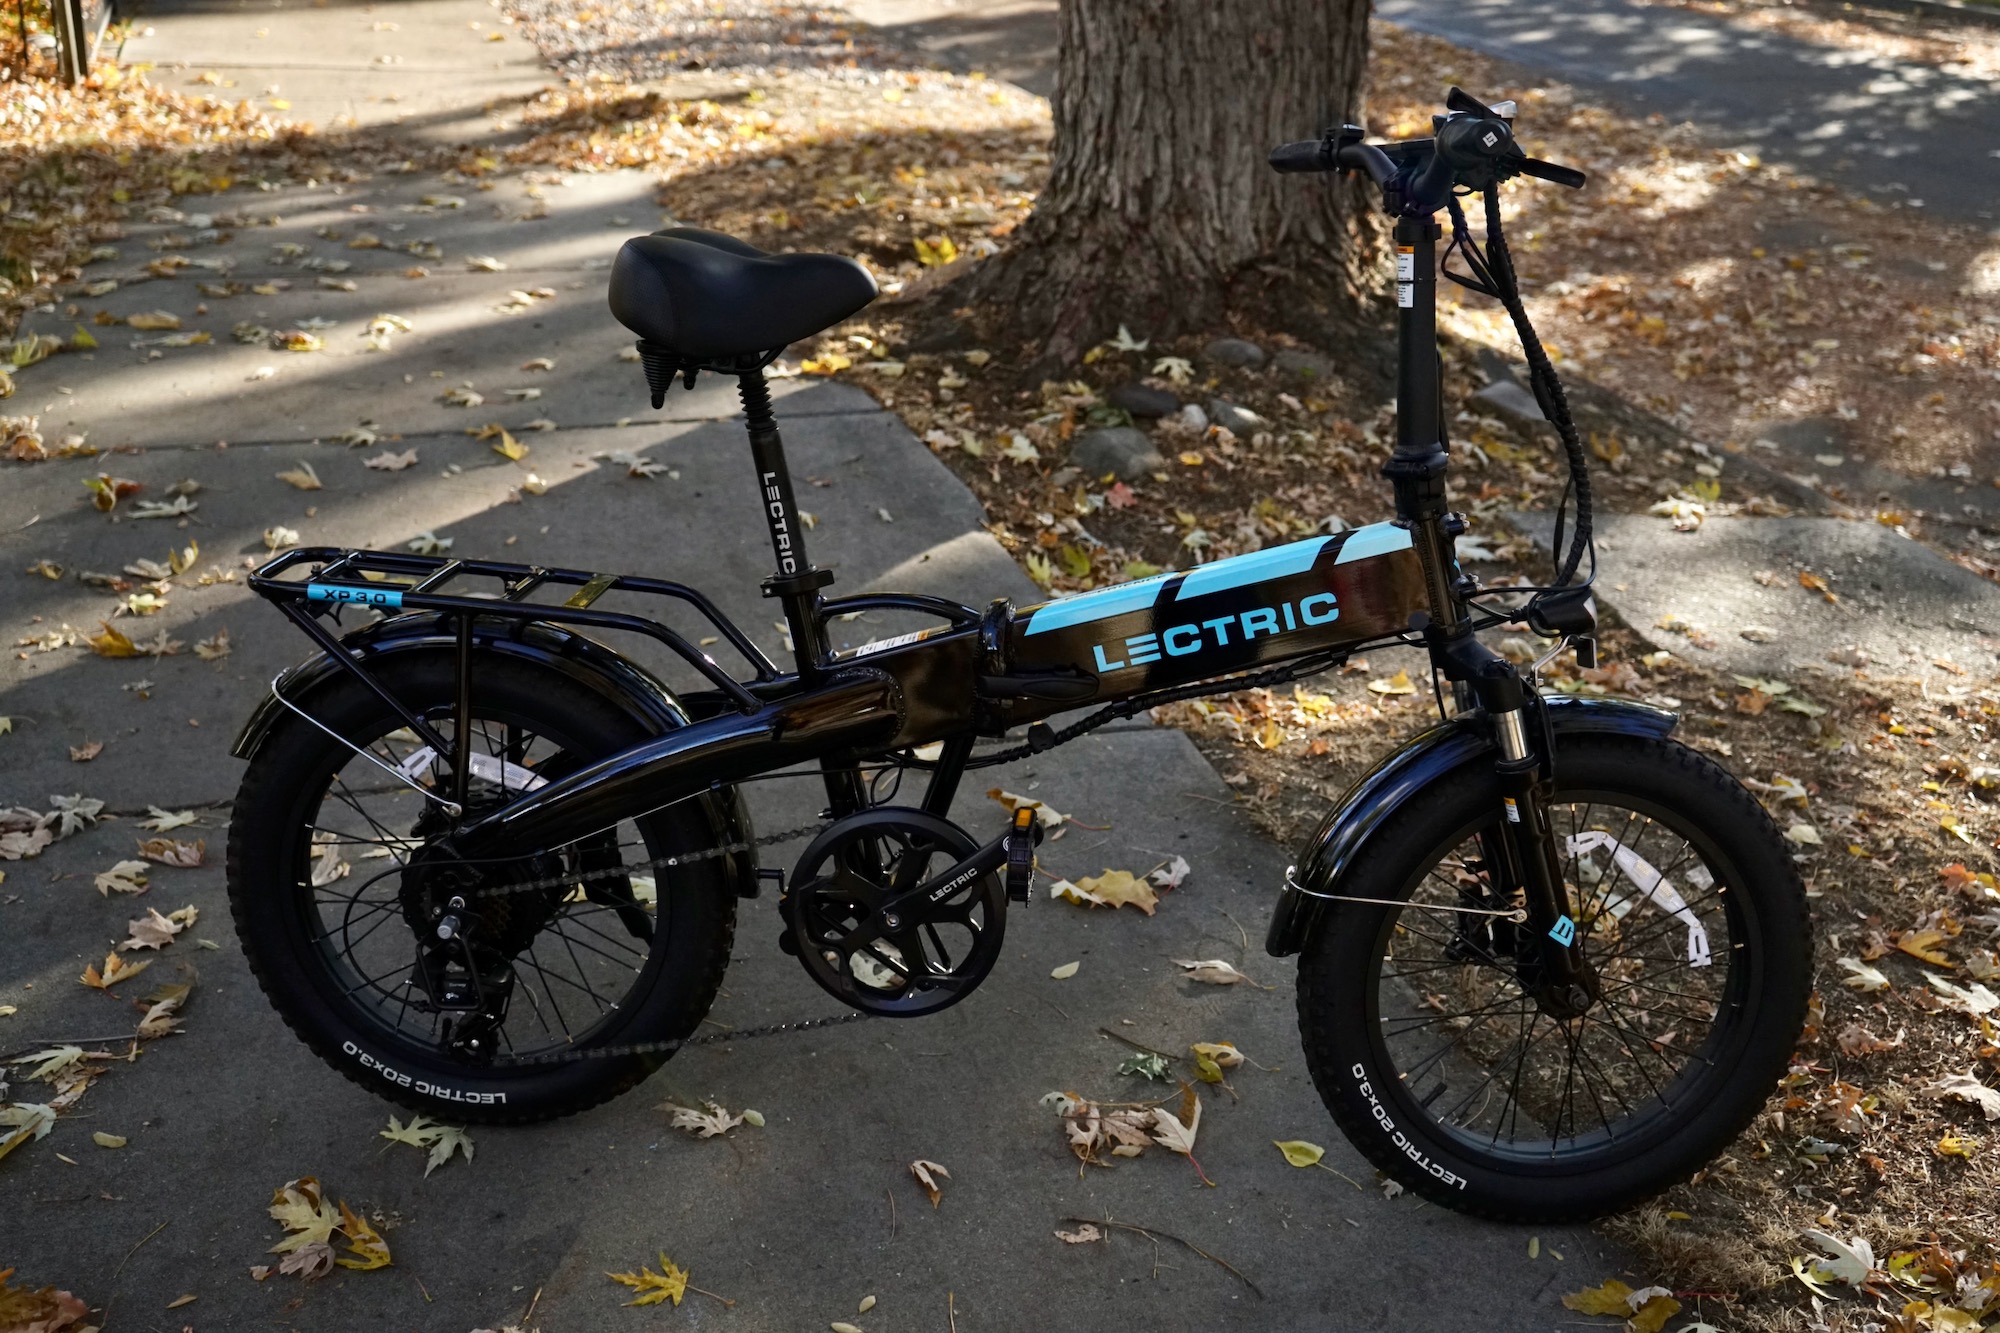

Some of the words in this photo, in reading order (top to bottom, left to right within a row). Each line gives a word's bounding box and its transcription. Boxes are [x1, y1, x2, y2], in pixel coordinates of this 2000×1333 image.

[763, 471, 797, 574] LECTRIC
[323, 589, 350, 600] XP
[355, 591, 386, 604] 3.0
[1093, 592, 1340, 673] LECTRIC
[929, 867, 978, 902] LECTRIC
[342, 1040, 412, 1088] 20x3.0
[415, 1080, 507, 1105] LECTRIC
[1351, 1062, 1395, 1133] 20x3.0
[1391, 1130, 1468, 1191] LECTRIC
